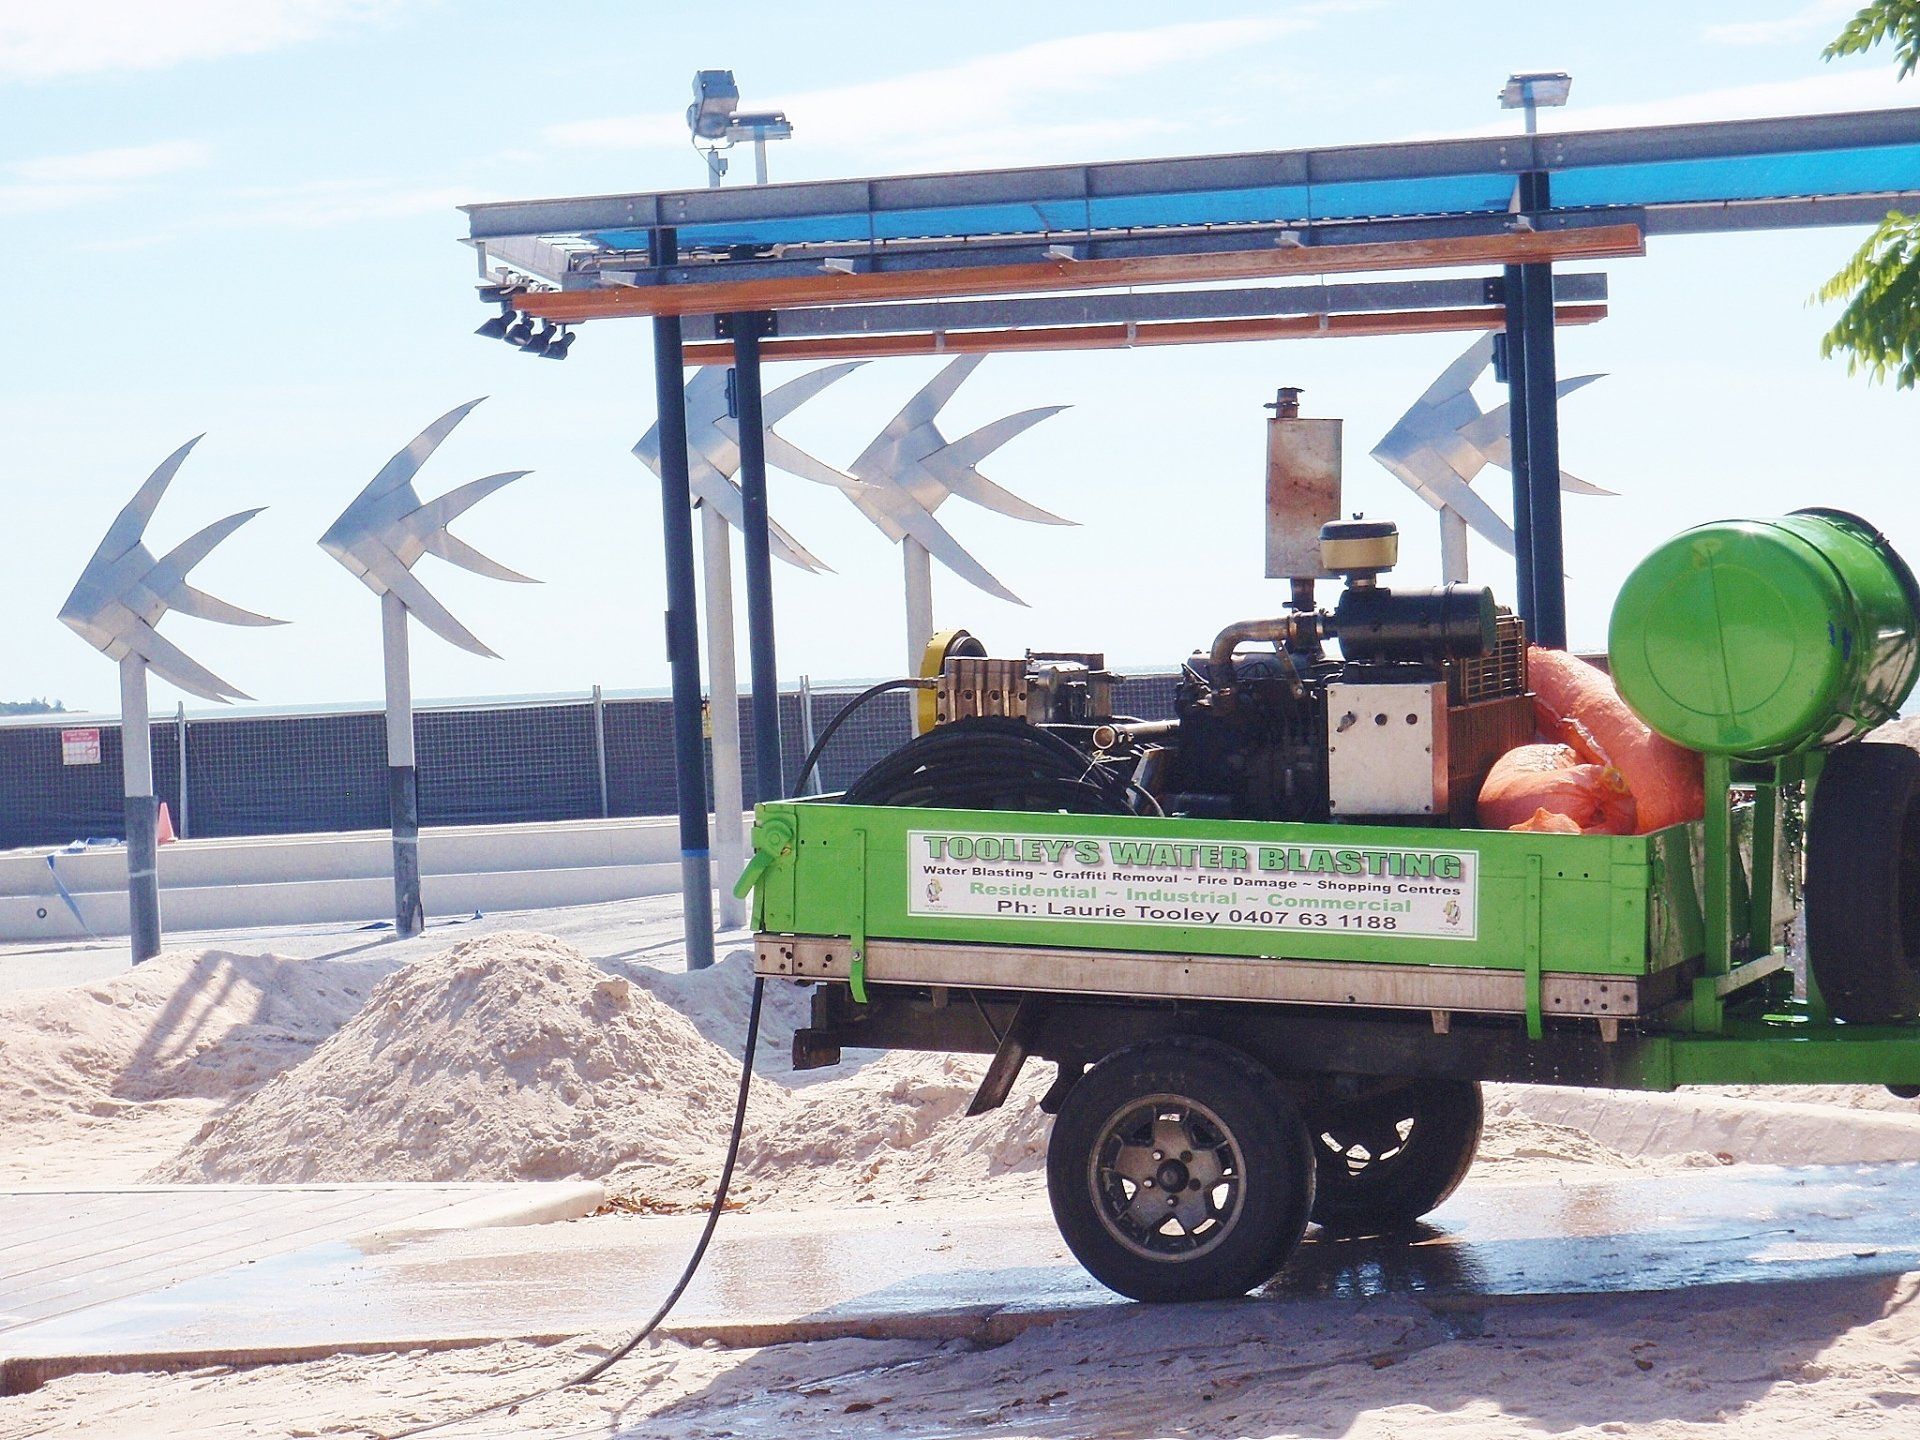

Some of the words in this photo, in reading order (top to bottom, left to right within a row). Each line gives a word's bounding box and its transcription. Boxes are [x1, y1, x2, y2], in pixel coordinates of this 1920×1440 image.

[923, 836, 1100, 864] TOOLEY'S
[1109, 842, 1248, 870] WATER
[1258, 847, 1461, 879] BLASTING
[923, 865, 967, 876] Water
[972, 867, 1034, 880] Blasting
[1053, 870, 1107, 881] Graffiti
[1112, 872, 1178, 883] Removal
[1198, 876, 1227, 885] Fire
[1233, 877, 1297, 889] Damage
[1318, 880, 1391, 894] Shopping
[1397, 883, 1460, 896] Centres
[970, 882, 1097, 899] Residential
[1127, 888, 1237, 905] Industrial
[1267, 893, 1411, 913] Commercial
[997, 900, 1037, 914] Ph:
[1048, 902, 1126, 918] Laurie
[1135, 905, 1220, 924] Tooley
[1229, 910, 1289, 925] 0407
[1299, 913, 1328, 926] 63
[1339, 915, 1397, 929] 1188
